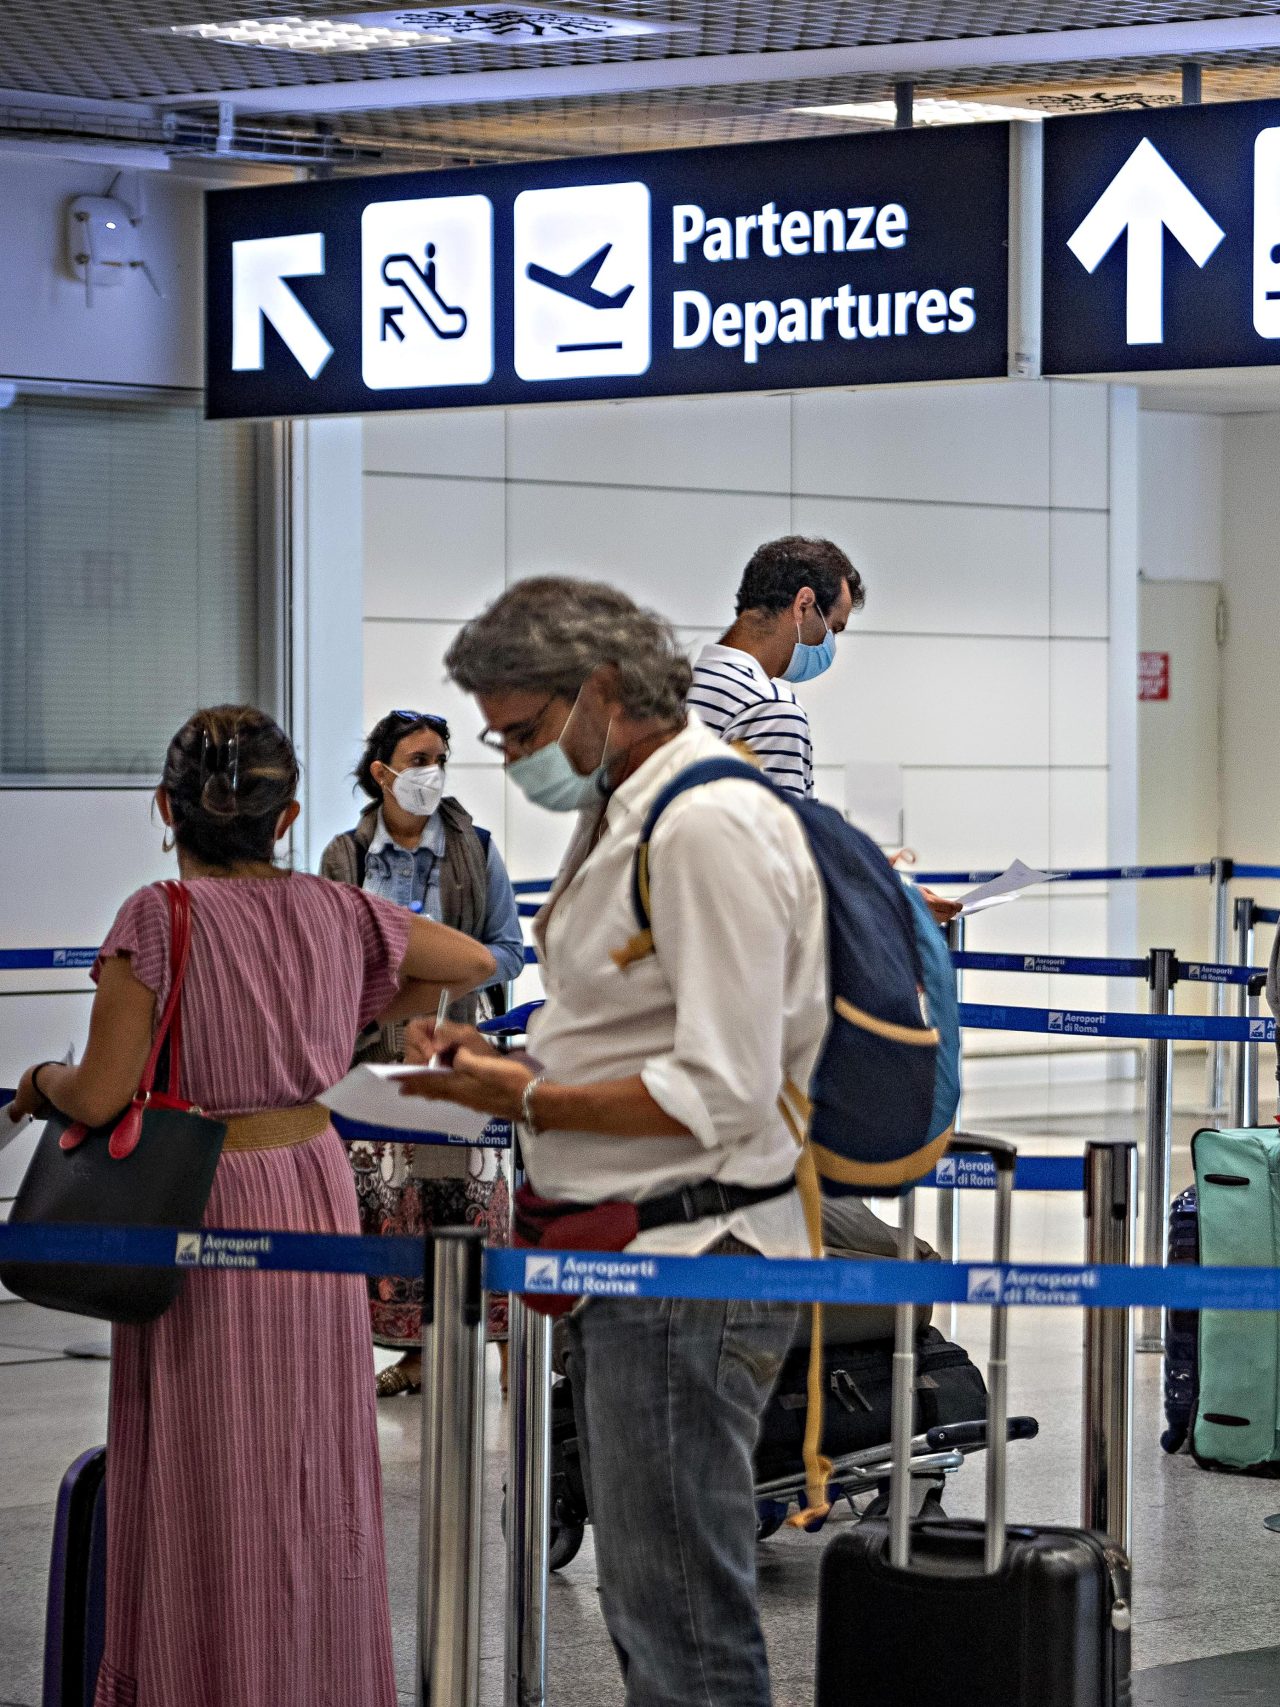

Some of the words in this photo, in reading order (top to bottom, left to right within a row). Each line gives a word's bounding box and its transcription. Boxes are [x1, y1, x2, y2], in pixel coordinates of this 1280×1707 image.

[672, 201, 909, 264] Partenze
[672, 283, 977, 364] Departures
[1065, 1013, 1106, 1024] Aeroporti
[1064, 1023, 1073, 1031] di
[1074, 1024, 1098, 1033] Roma
[1267, 1031, 1275, 1039] di
[958, 1173, 968, 1185] di
[970, 1174, 995, 1185] Rom
[204, 1233, 269, 1252] Aeroporti
[202, 1251, 214, 1265] di
[217, 1251, 256, 1266] Roma
[563, 1258, 654, 1277] Aeroporti
[561, 1276, 579, 1293] di
[583, 1276, 637, 1293] Roma
[1005, 1268, 1095, 1288] Aeroporti
[1004, 1287, 1021, 1303] di
[1024, 1287, 1079, 1303] Roma
